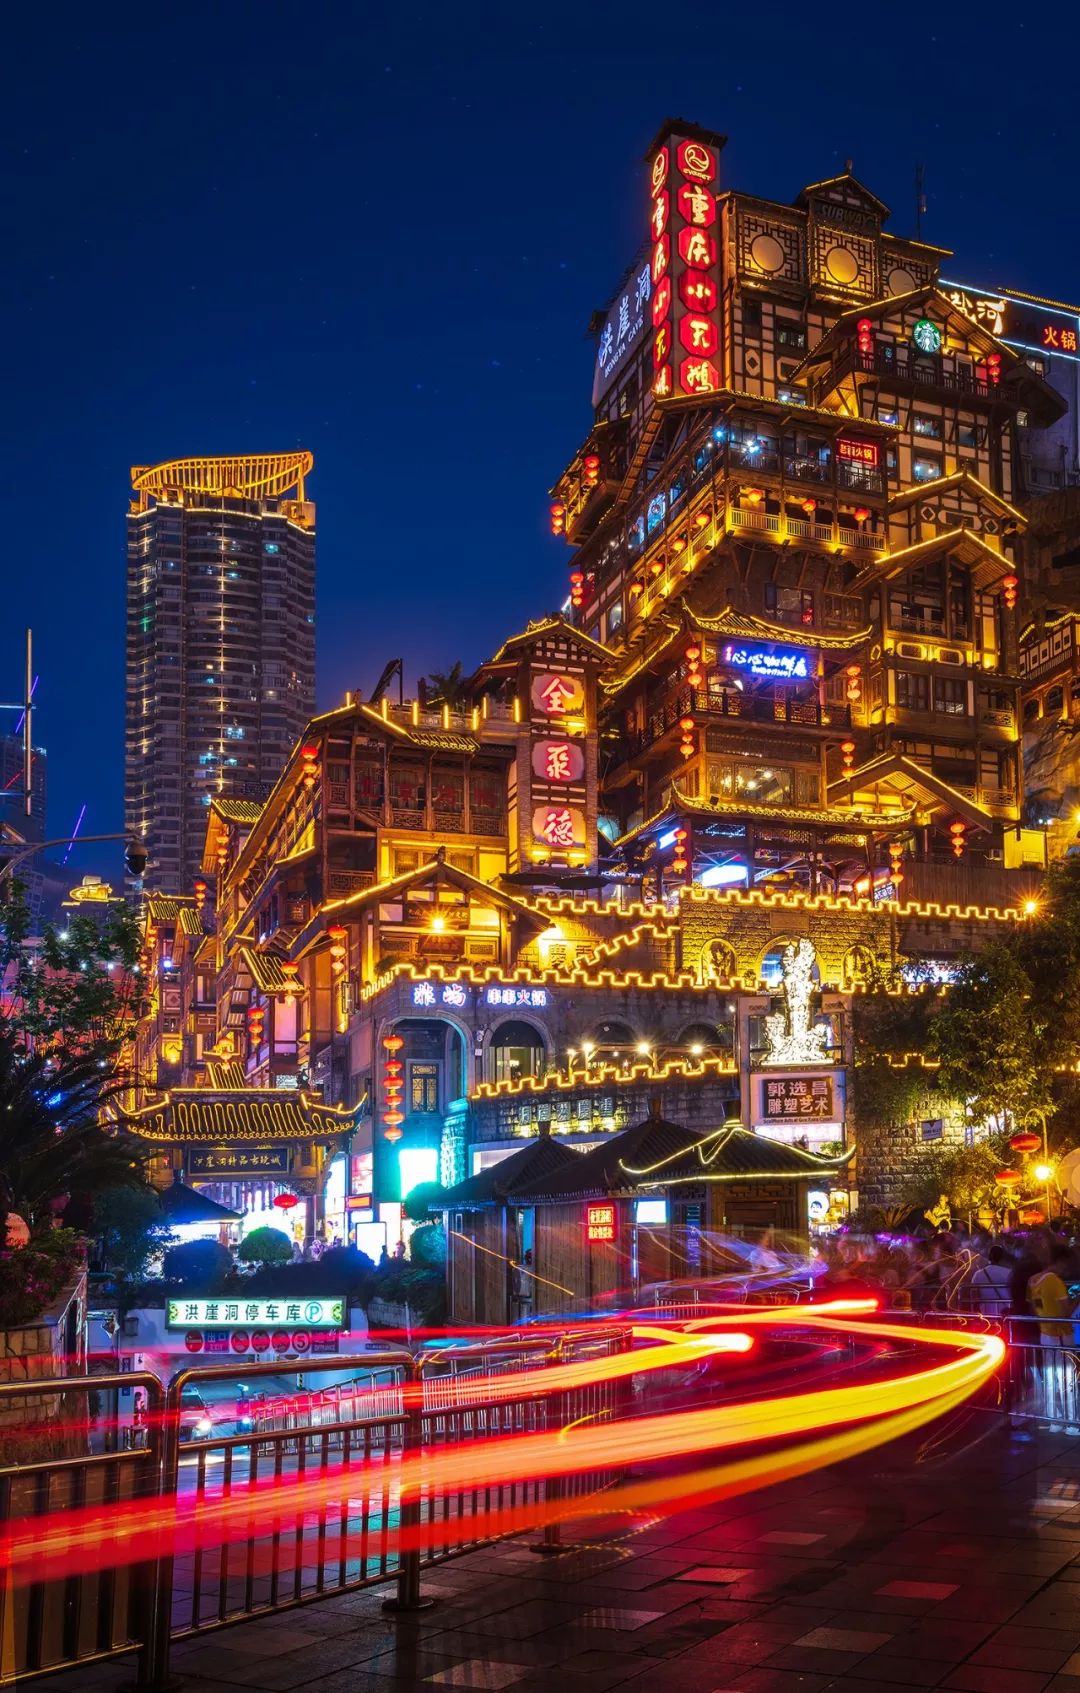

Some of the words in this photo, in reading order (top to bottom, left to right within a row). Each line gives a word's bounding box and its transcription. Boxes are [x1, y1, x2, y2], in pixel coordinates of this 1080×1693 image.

[822, 205, 873, 226] SUBWAY
[683, 185, 715, 391] 重庆小天鹅
[1043, 326, 1077, 351] 火锅
[768, 1080, 828, 1097] 郭选昌
[768, 1098, 828, 1115] 雕塑艺术
[185, 1303, 301, 1321] 洪崖洞停车库
[297, 1332, 306, 1349] 5
